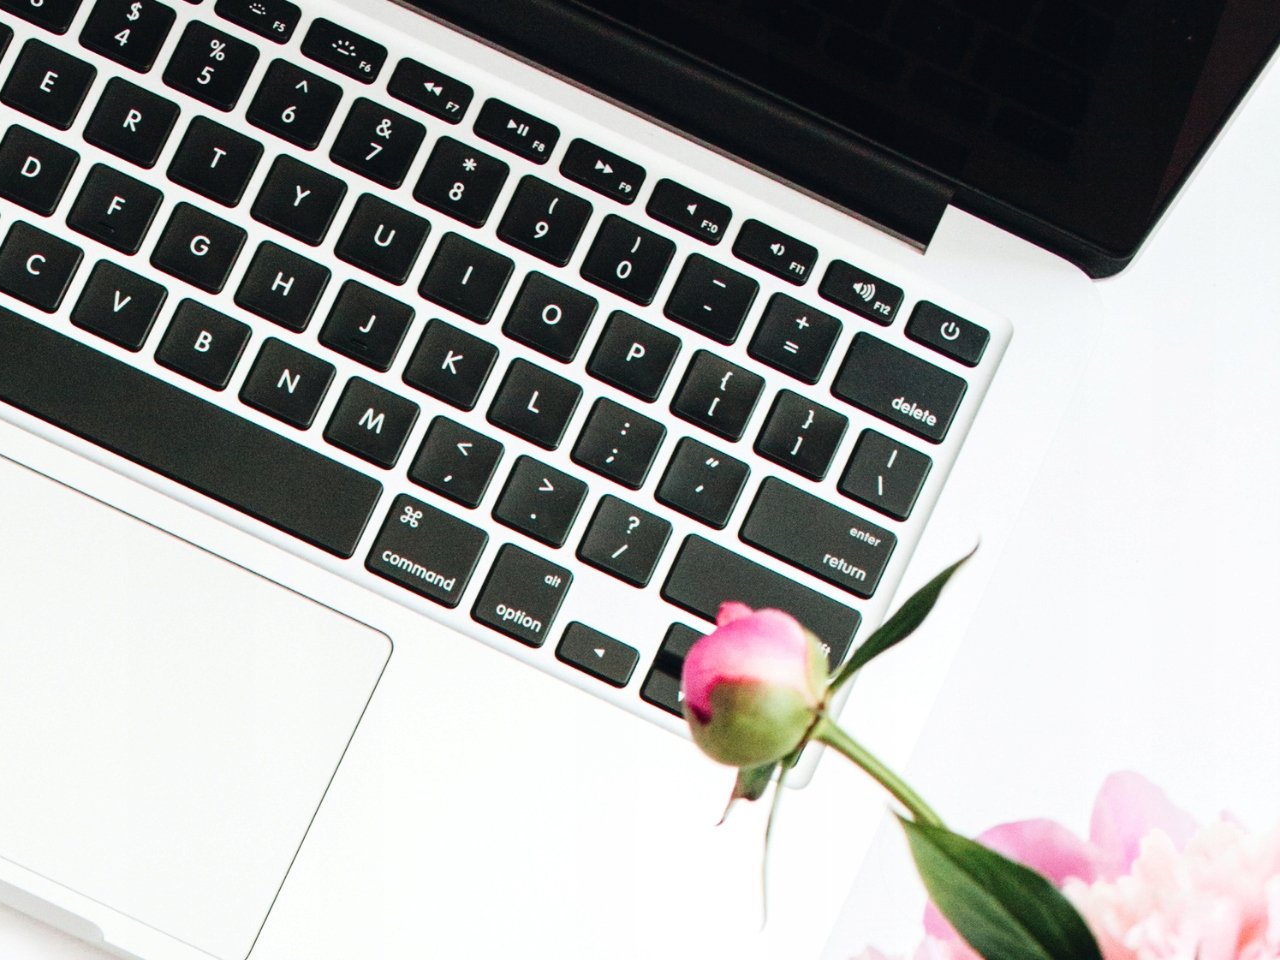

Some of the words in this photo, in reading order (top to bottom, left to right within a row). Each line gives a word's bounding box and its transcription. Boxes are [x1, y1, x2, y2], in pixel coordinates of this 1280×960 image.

[272, 20, 286, 32] F5
[114, 28, 131, 47] 4
[196, 66, 215, 85] 5
[358, 60, 372, 73] F6
[39, 70, 59, 93] E
[281, 105, 297, 123] 6
[445, 101, 460, 113] F7
[122, 108, 142, 132] R
[365, 142, 383, 161] 7
[532, 140, 545, 153] F8
[20, 155, 42, 178] D
[210, 147, 227, 169] T
[293, 185, 311, 207] Y
[448, 182, 465, 201] 8
[618, 181, 632, 193] F9
[106, 195, 126, 215] F
[373, 224, 396, 247] U
[533, 221, 549, 239] 9
[700, 219, 719, 234] F10
[189, 235, 211, 256] G
[26, 254, 46, 276] C
[461, 265, 474, 285] I
[616, 260, 632, 279] 0
[789, 261, 806, 275] F11
[271, 271, 295, 297] H
[113, 290, 132, 313] V
[873, 301, 891, 316] F12
[358, 314, 377, 333] J
[541, 303, 562, 325] O
[193, 330, 213, 353] B
[625, 342, 646, 362] P
[441, 350, 464, 375] K
[276, 368, 301, 394] N
[527, 390, 540, 414] L
[890, 395, 937, 427] delete
[358, 407, 385, 434] M
[849, 526, 882, 548] enter
[381, 547, 456, 592] command
[822, 551, 867, 583] return
[544, 572, 562, 589] alt
[495, 602, 542, 633] option
